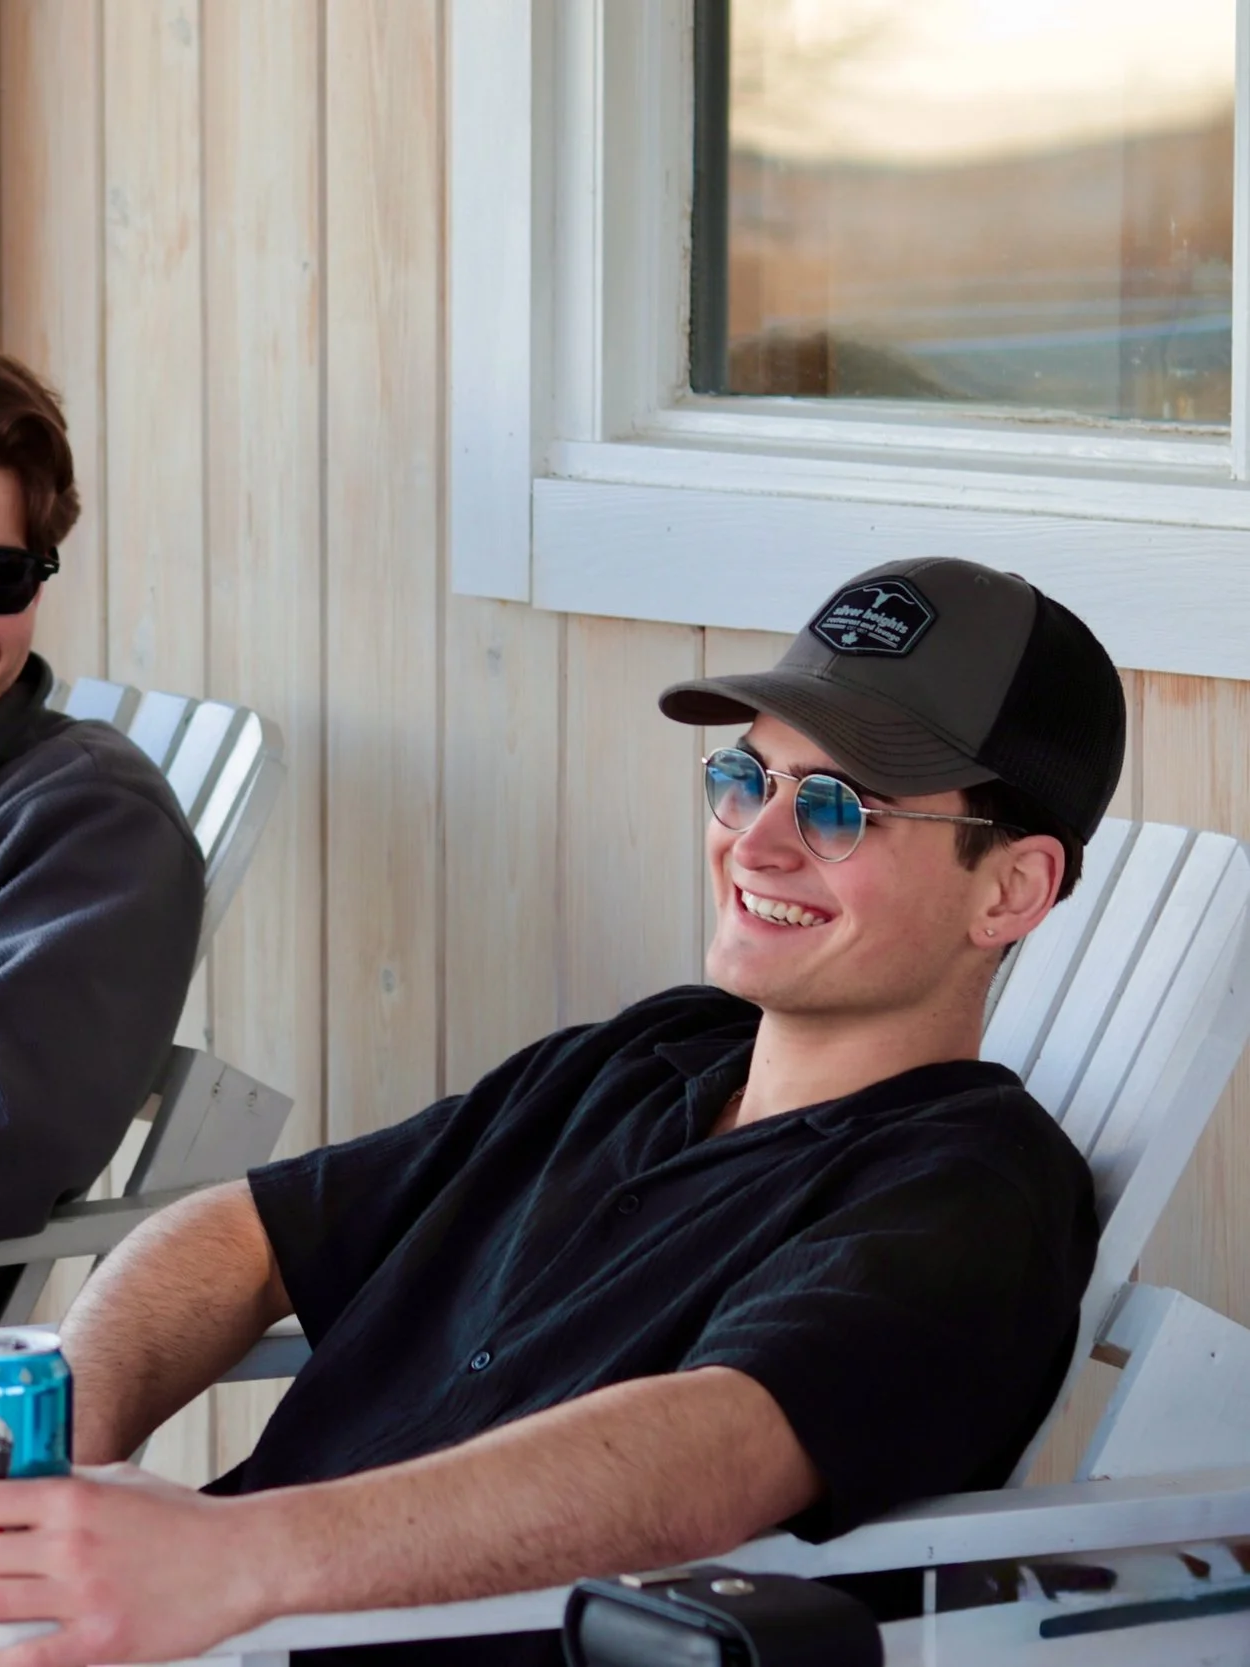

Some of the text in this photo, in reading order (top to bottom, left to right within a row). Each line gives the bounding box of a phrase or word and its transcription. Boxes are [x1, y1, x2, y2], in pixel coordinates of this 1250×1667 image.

[833, 605, 863, 617] silver
[862, 608, 909, 634] heights
[860, 621, 876, 631] and
[875, 625, 901, 642] lounge
